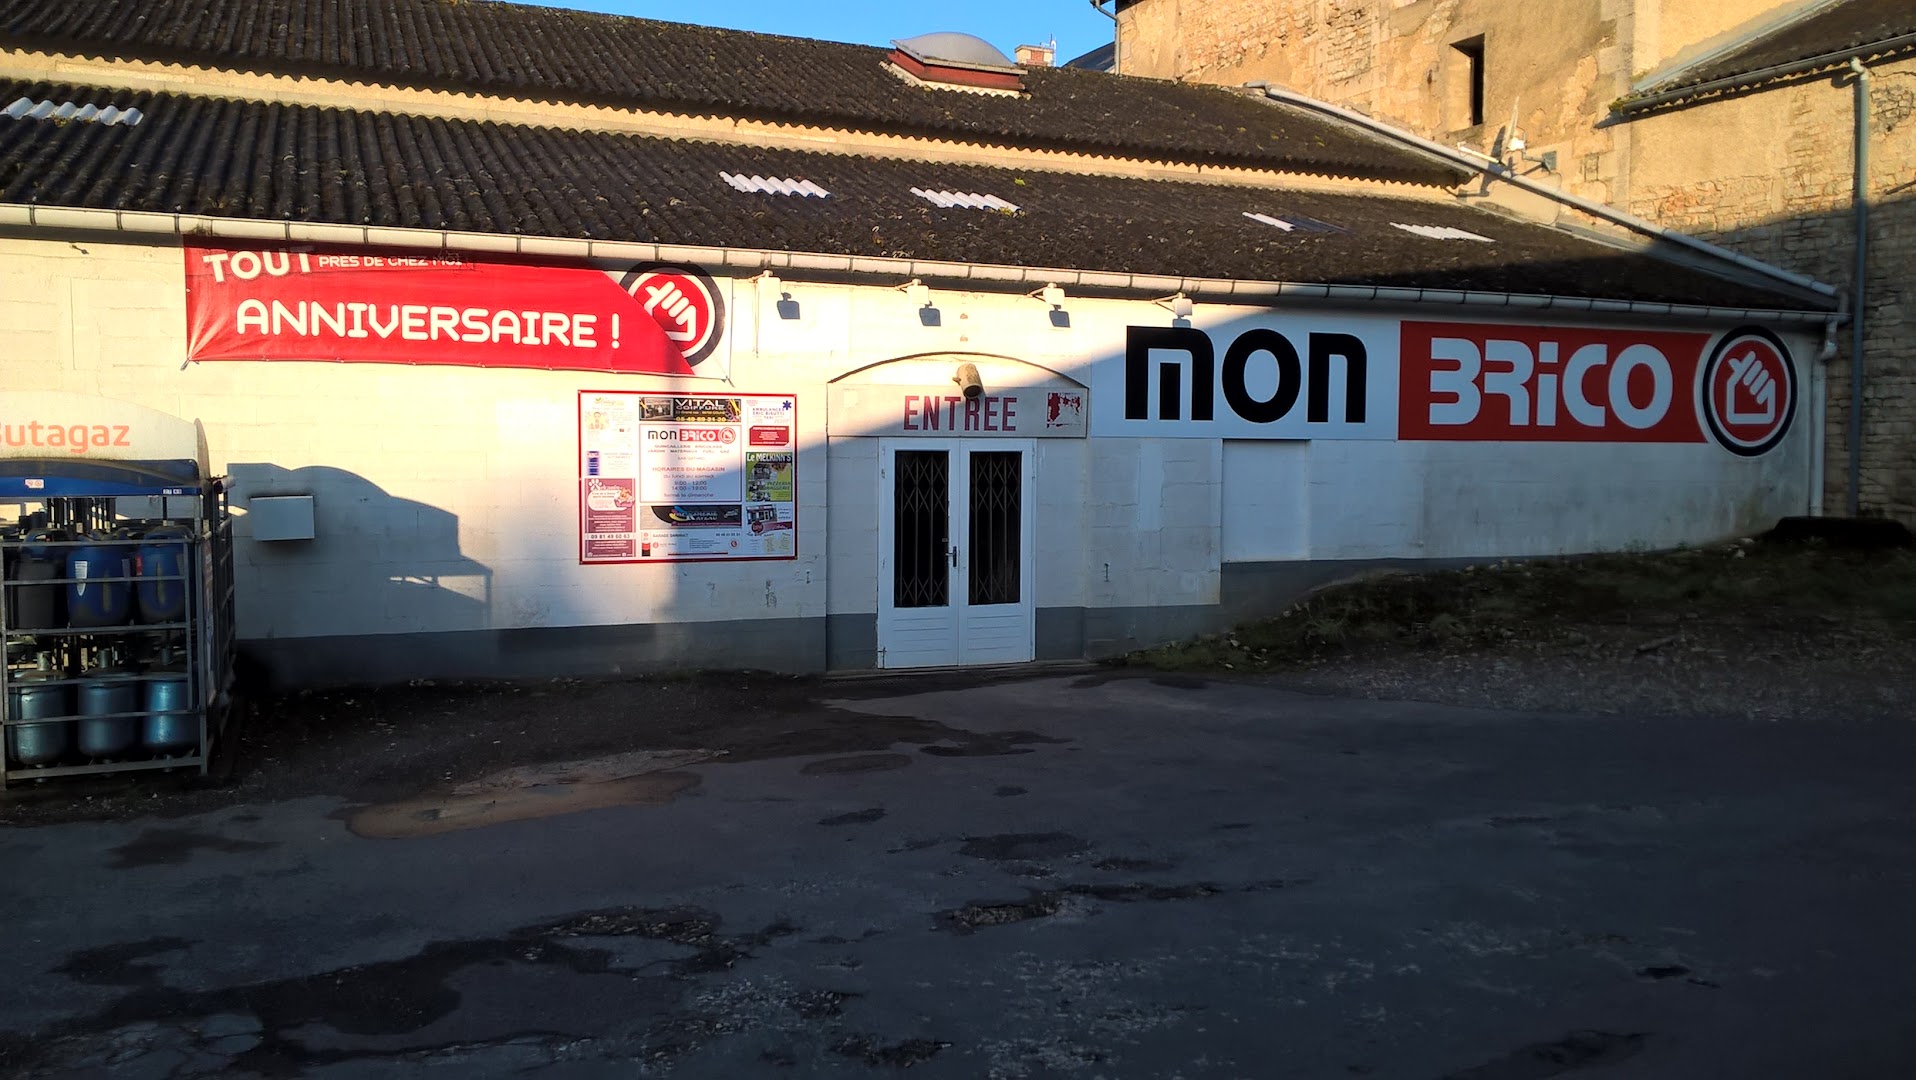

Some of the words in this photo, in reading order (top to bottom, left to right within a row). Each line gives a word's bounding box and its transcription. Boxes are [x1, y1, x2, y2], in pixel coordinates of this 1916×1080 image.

[202, 245, 315, 283] TOUT
[363, 256, 385, 267] DE
[387, 255, 429, 267] CHEZ
[236, 298, 598, 349] ANNIVERSAIRE
[611, 312, 620, 350] !
[674, 398, 725, 407] VITAL
[903, 395, 1018, 431] ENTREE
[0, 420, 130, 454] utagaz
[746, 452, 756, 462] Le
